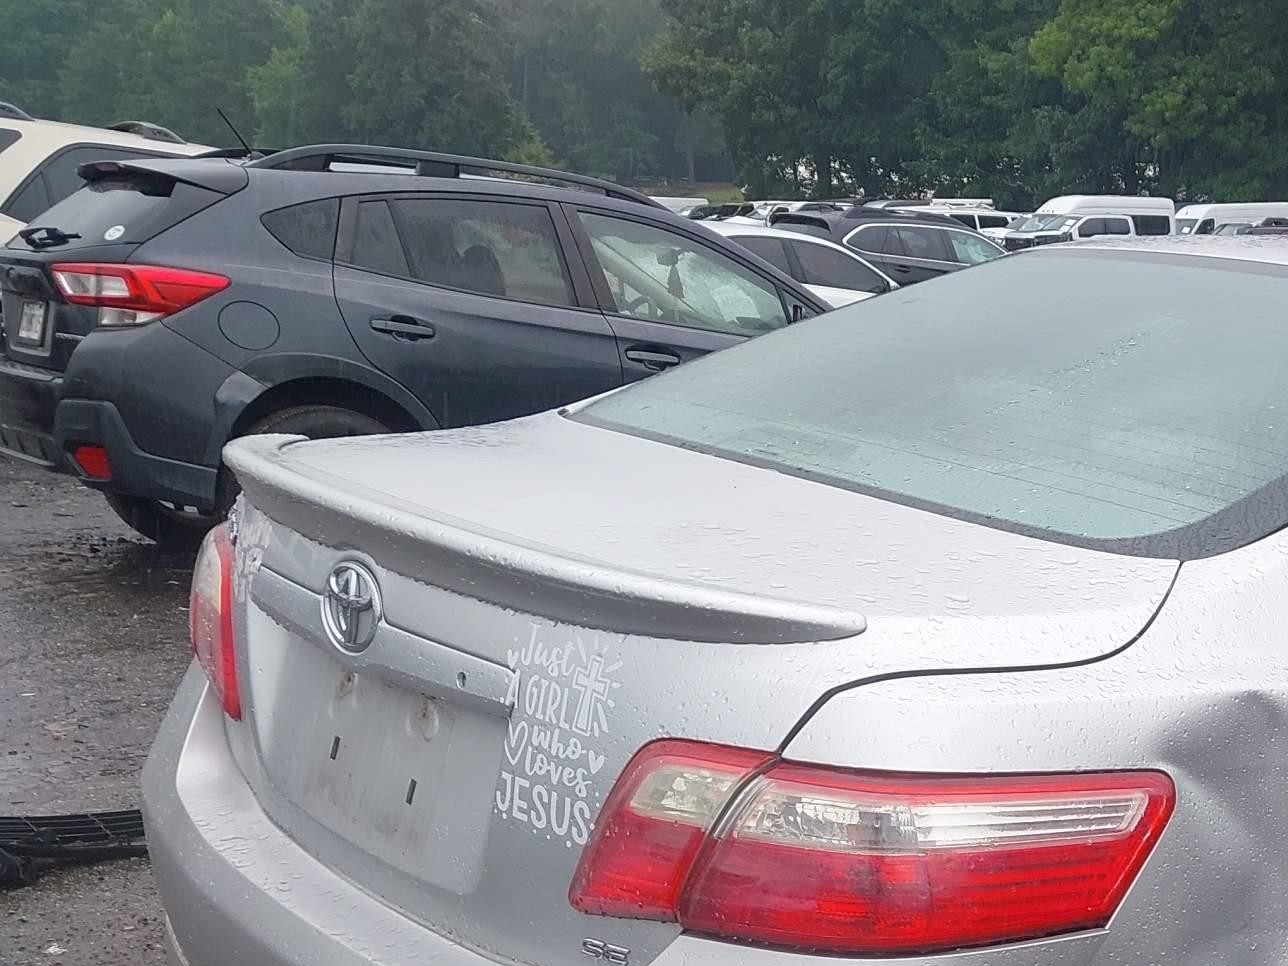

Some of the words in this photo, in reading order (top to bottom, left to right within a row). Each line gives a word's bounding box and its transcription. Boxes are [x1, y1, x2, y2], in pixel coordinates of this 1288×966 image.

[521, 621, 575, 677] Just
[504, 668, 520, 709] A
[525, 675, 570, 730] GIRL
[531, 724, 587, 760] who
[525, 745, 592, 798] loves
[496, 771, 591, 845] JESUS
[581, 937, 631, 966] SE
